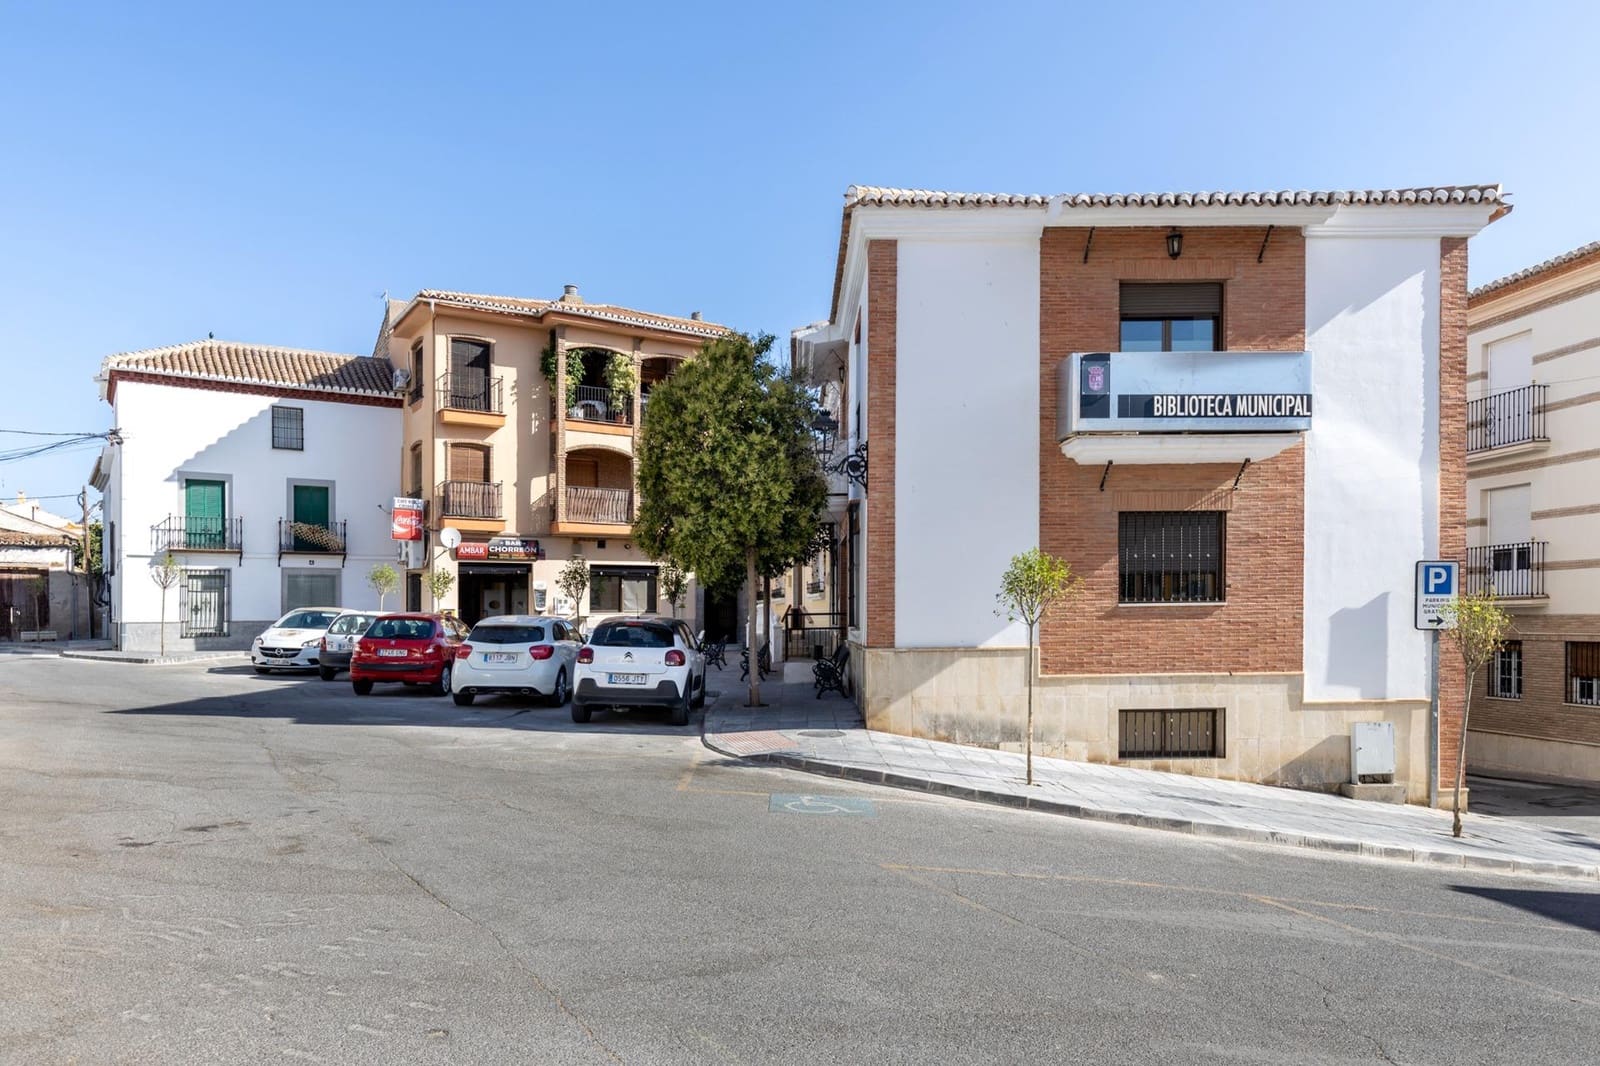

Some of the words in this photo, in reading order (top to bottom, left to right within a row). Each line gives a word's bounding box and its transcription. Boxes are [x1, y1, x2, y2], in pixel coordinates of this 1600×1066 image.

[1153, 395, 1231, 417] BIBLIOTECA
[1235, 395, 1311, 417] MUNICIPAL
[1428, 567, 1447, 593] P
